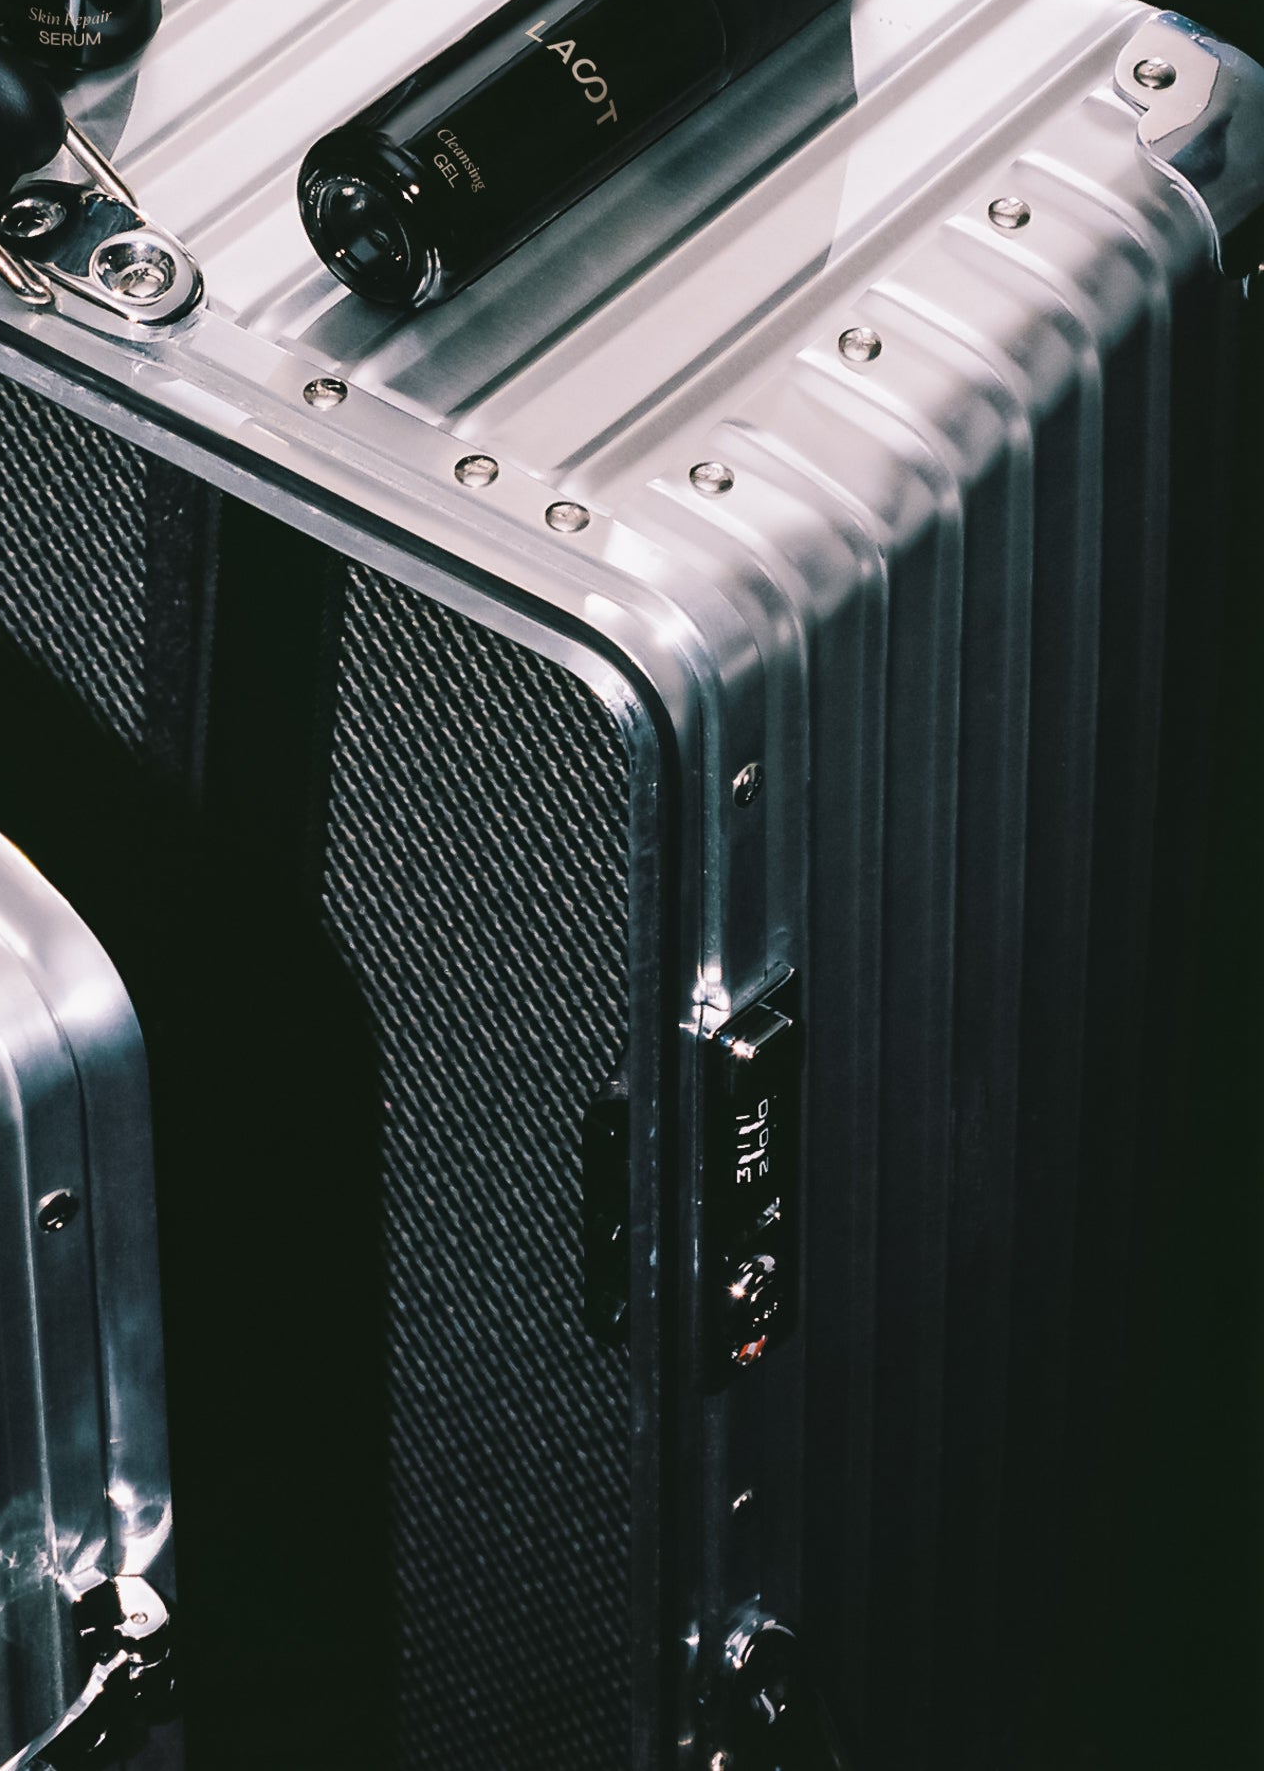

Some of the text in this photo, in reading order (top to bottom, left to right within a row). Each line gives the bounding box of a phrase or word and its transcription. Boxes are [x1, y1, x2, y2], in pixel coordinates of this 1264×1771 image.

[28, 7, 61, 26] Skin
[38, 30, 102, 47] SERUM
[433, 154, 460, 189] GEL
[437, 129, 486, 194] Cleansing
